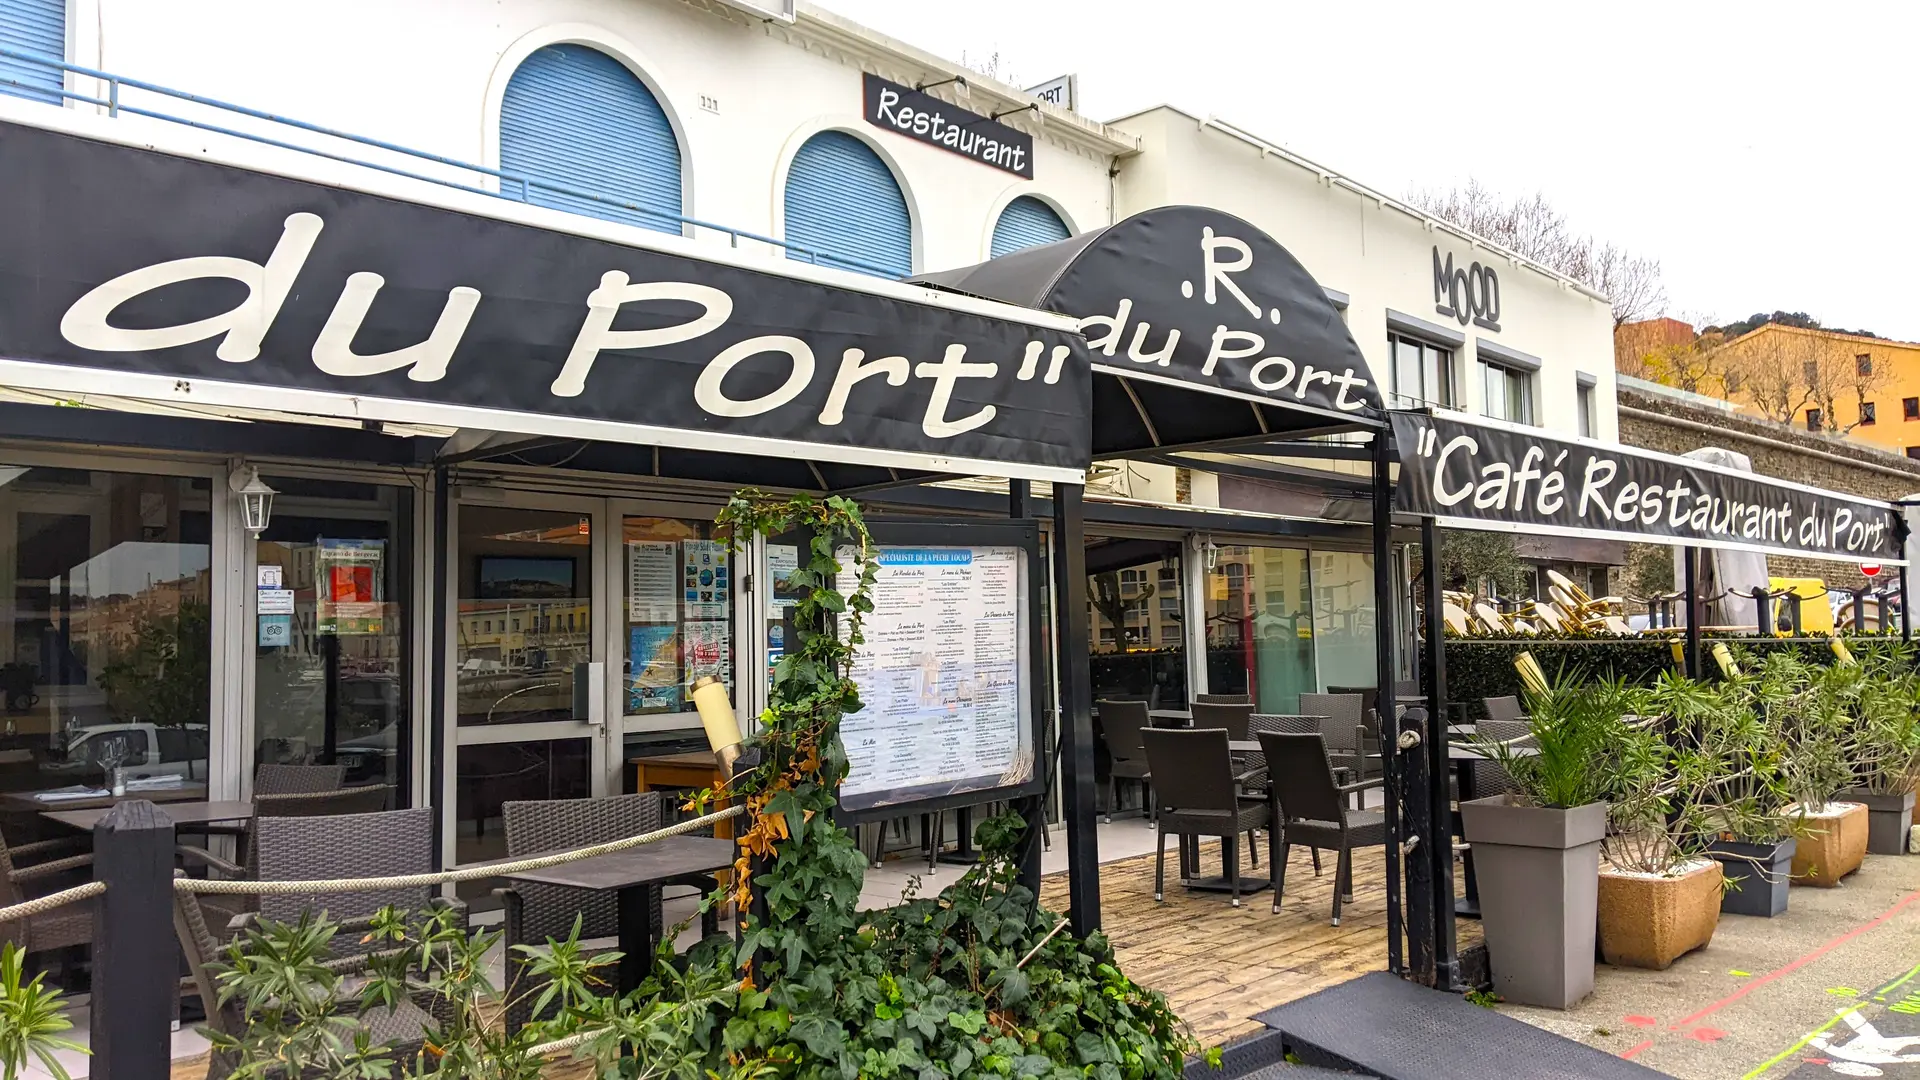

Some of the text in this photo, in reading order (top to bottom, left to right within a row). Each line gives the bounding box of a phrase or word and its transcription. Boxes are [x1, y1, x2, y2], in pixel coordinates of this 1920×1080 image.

[877, 87, 1025, 171] Restaurant
[60, 212, 481, 382] du
[1079, 298, 1367, 410] du Port
[1578, 456, 1793, 543] Restaurant
[1799, 502, 1827, 548] du
